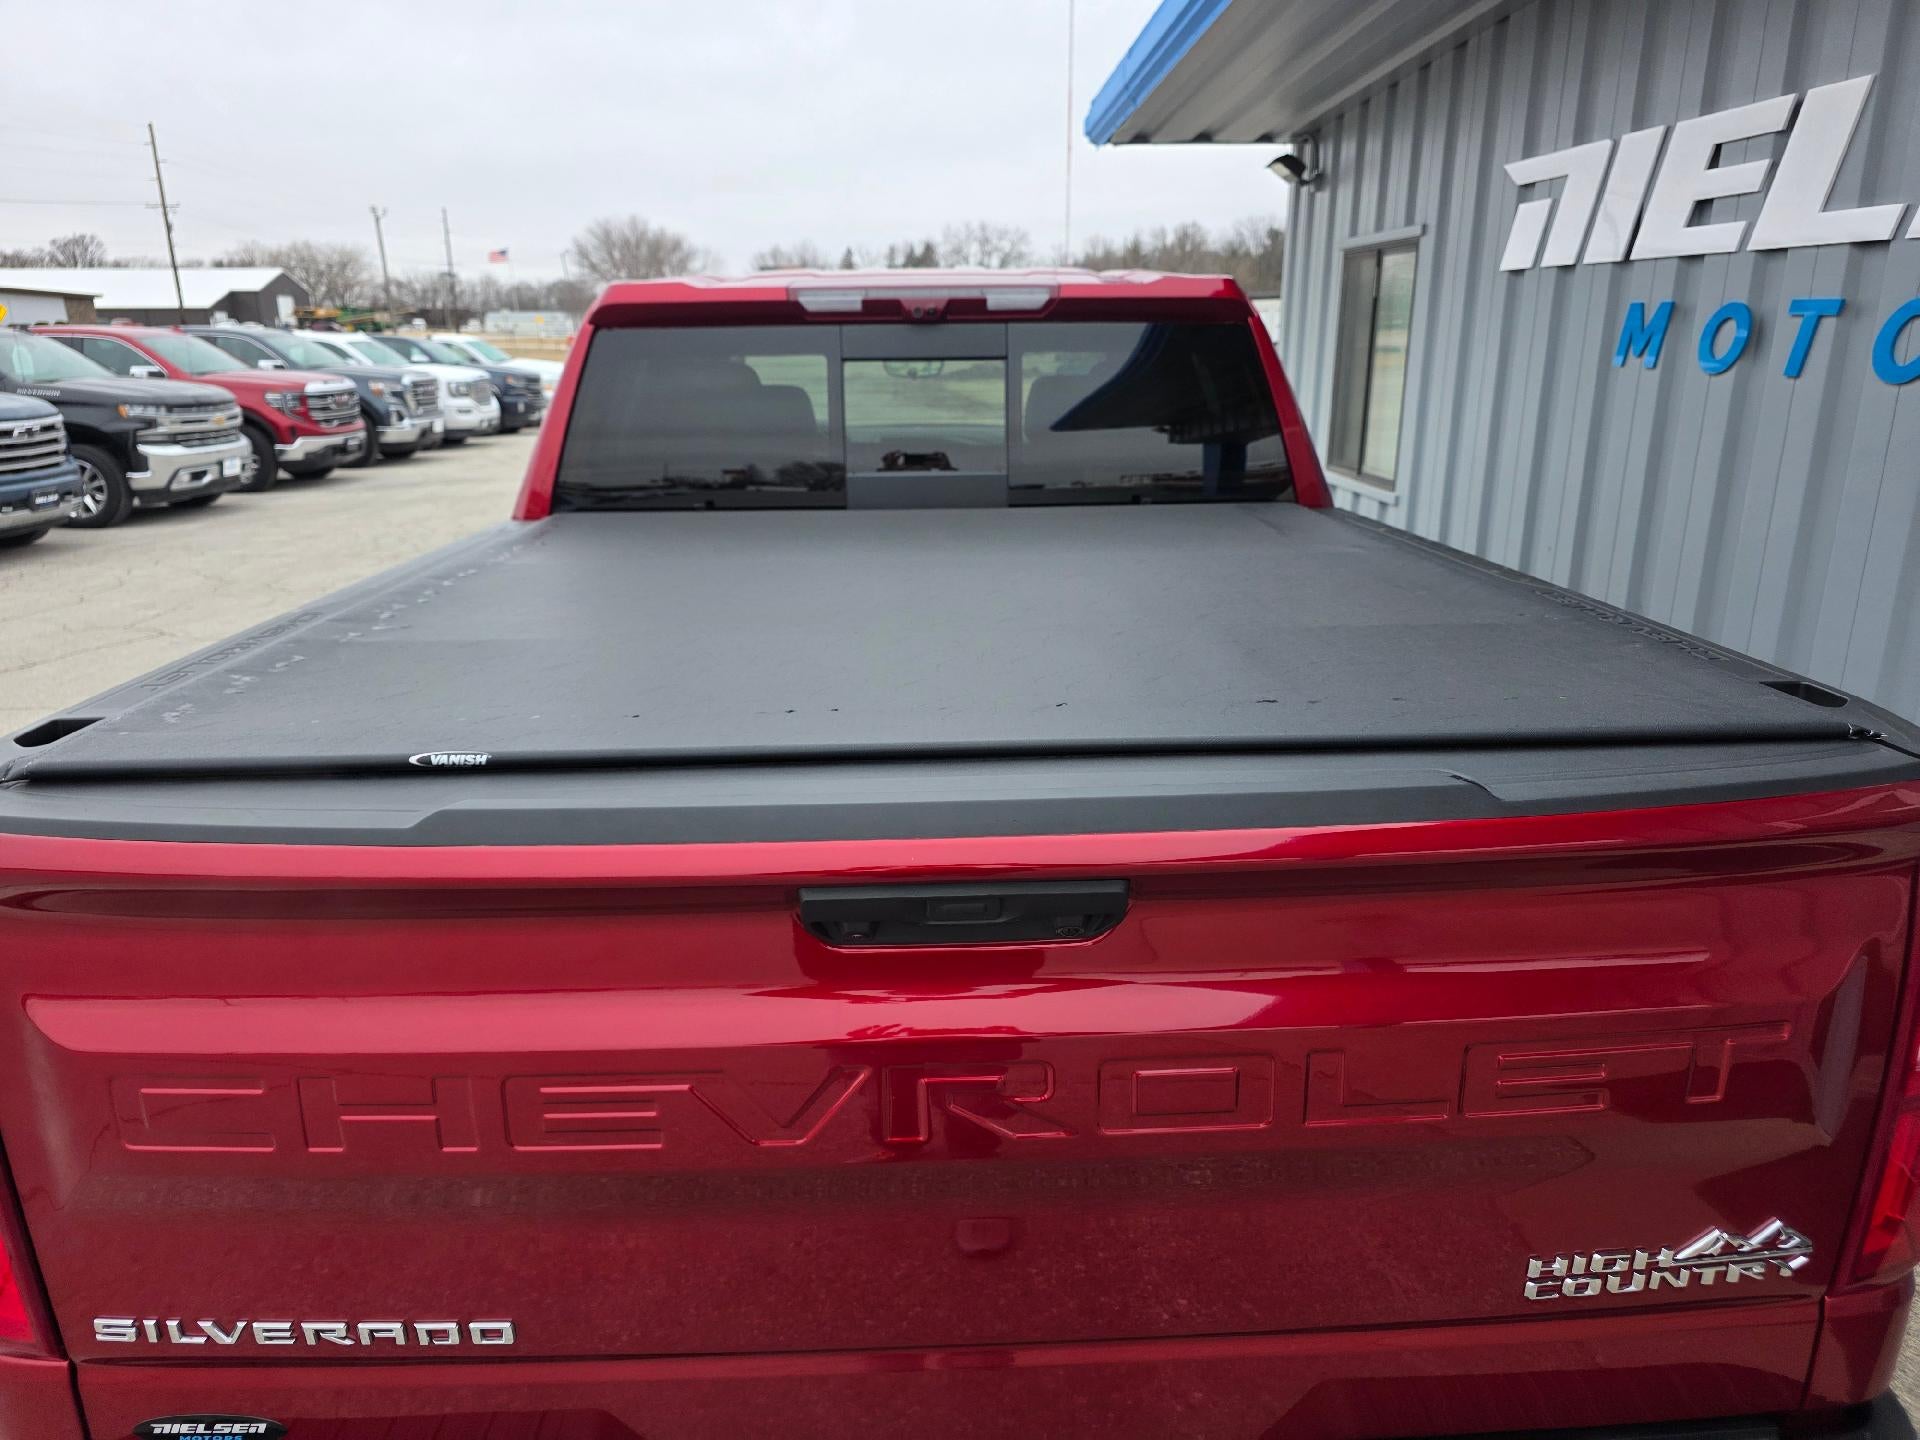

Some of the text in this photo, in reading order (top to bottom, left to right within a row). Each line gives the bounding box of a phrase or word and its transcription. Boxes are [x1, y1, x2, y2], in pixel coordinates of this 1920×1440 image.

[1500, 74, 1920, 271] NIEL
[430, 754, 488, 766] VANISH
[110, 1021, 1793, 1155] CHEVROLET
[1523, 1255, 1810, 1301] COUNTRY
[1526, 1247, 1675, 1279] HIGH
[92, 1317, 517, 1346] SILVERADO
[150, 1423, 267, 1434] NIELSEN
